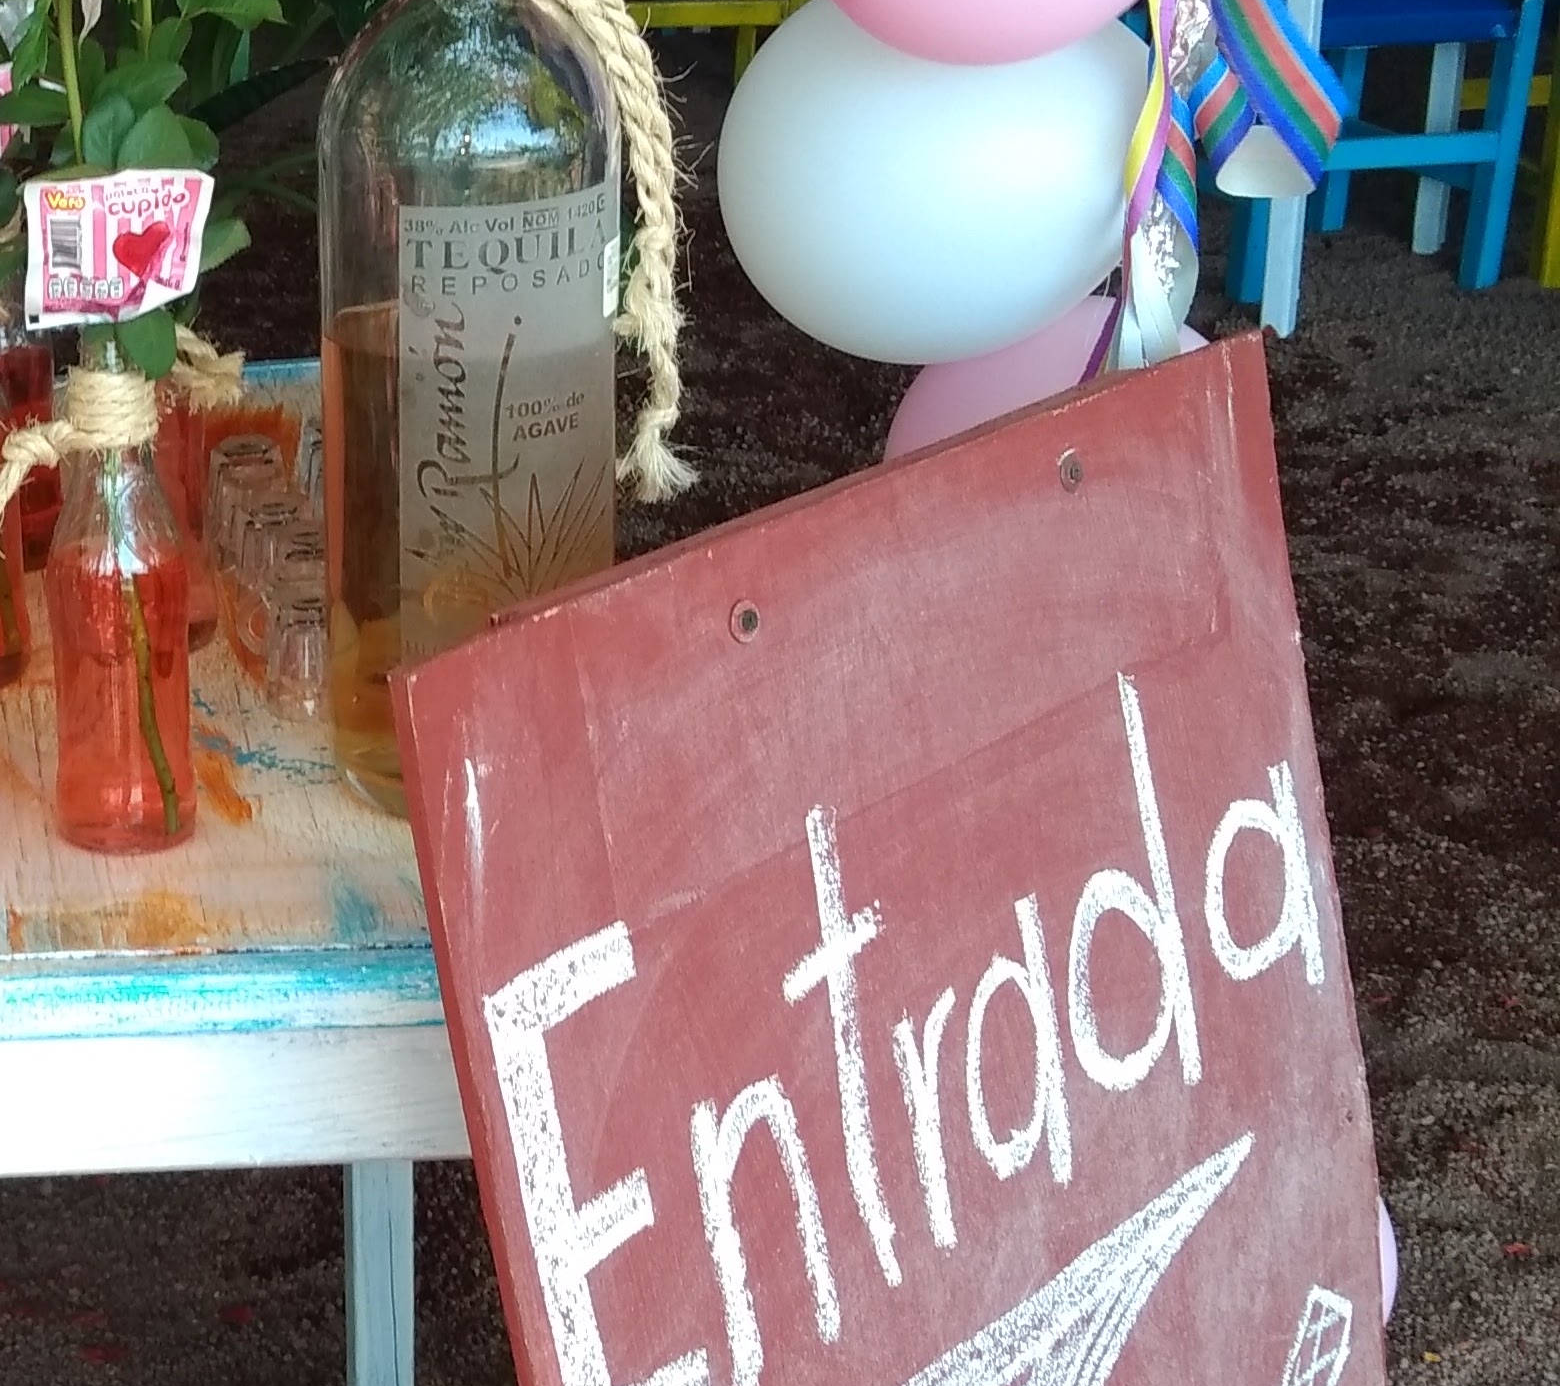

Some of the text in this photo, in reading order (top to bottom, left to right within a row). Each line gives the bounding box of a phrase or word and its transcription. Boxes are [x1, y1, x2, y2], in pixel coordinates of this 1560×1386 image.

[107, 188, 187, 218] cupido
[404, 218, 443, 236] 38%
[449, 219, 479, 234] Alc
[484, 216, 515, 232] Vol
[523, 210, 559, 230] NOM
[405, 218, 606, 275] TEQUILA
[506, 397, 560, 420] 100%
[512, 413, 580, 443] AGAVE
